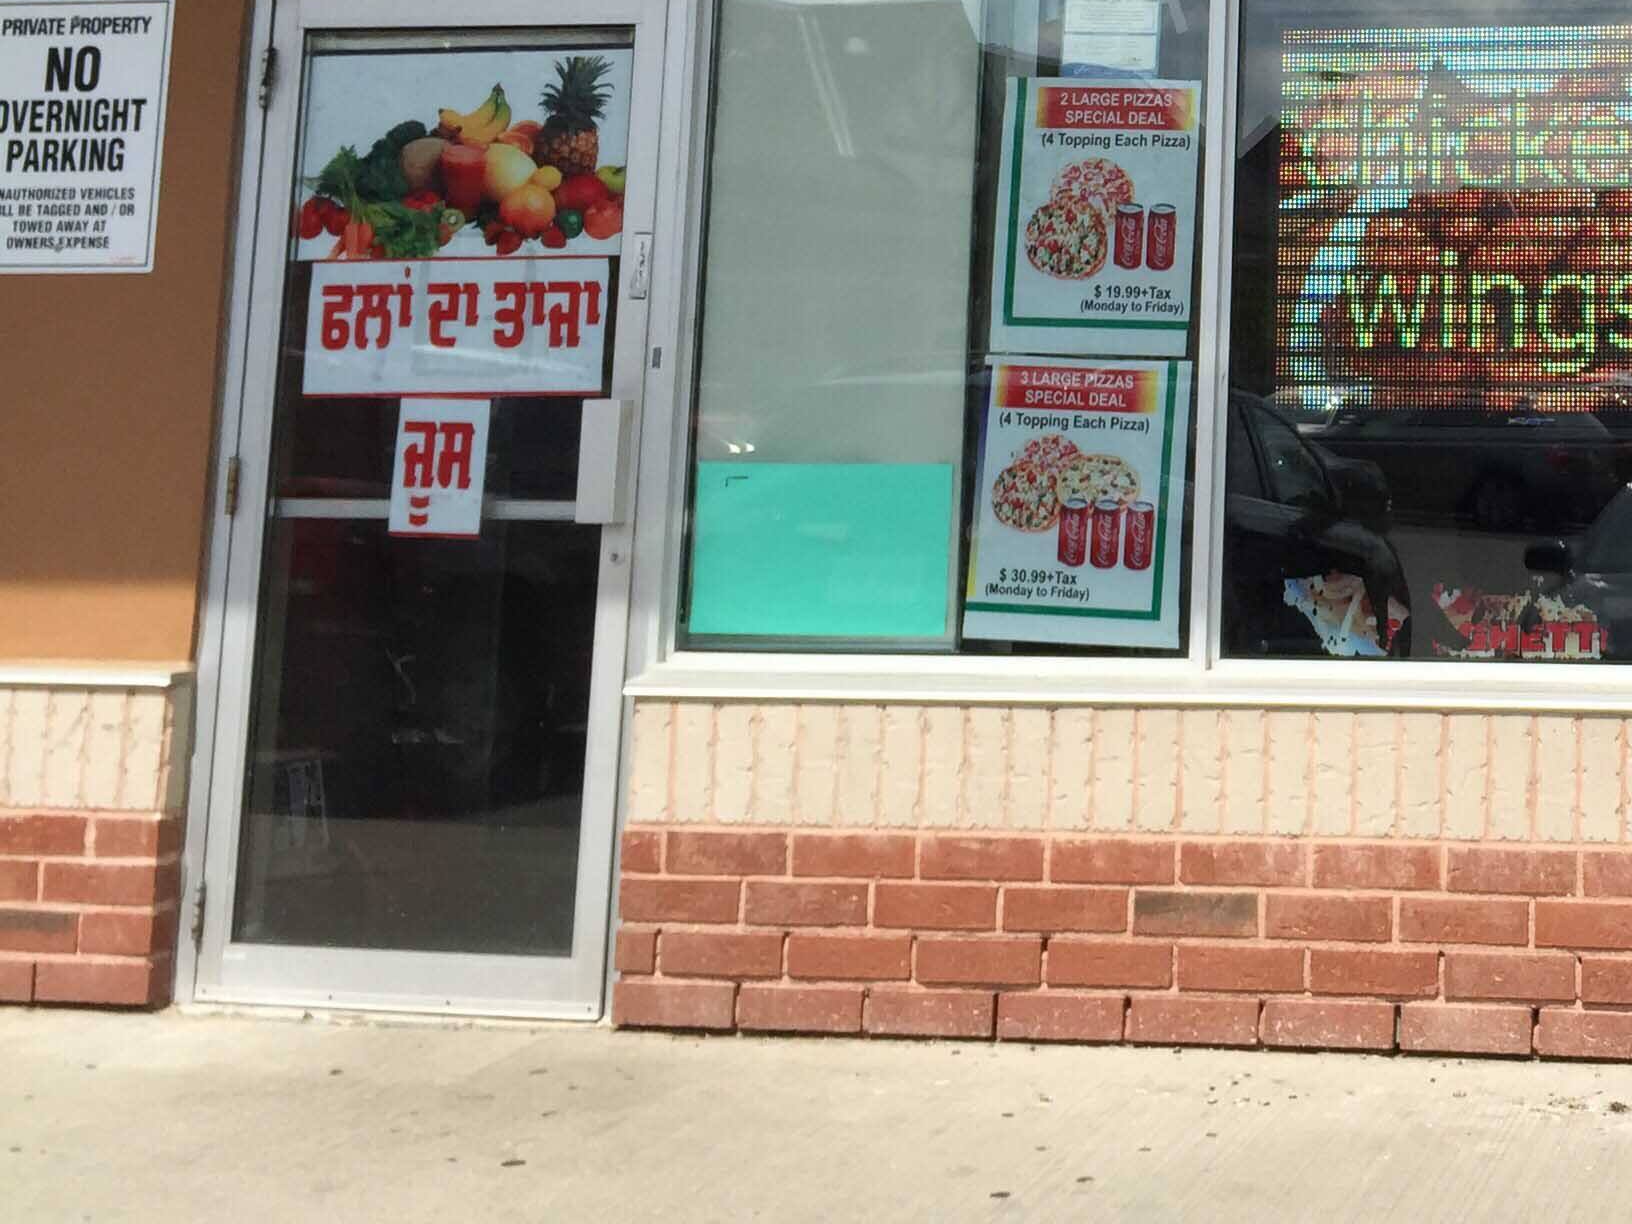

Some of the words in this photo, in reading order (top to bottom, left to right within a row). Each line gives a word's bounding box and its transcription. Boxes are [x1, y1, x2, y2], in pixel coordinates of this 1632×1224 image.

[2, 17, 66, 36] PRIVATE
[70, 16, 152, 35] PROPERTY
[45, 45, 102, 92] NO
[1059, 93, 1068, 106] 2
[1071, 92, 1119, 106] LARGE
[1123, 94, 1173, 107] PIZZAS
[0, 98, 147, 133] OVERNIGHT
[1065, 110, 1124, 125] SPECIAL
[1128, 111, 1165, 125] DEAL
[1041, 132, 1054, 148] (4
[1058, 133, 1110, 150] Topping
[1115, 134, 1148, 147] Each
[1151, 134, 1191, 150] Pizza)
[6, 138, 125, 173] PARKING
[80, 187, 136, 201] VEHICLES
[18, 204, 32, 217] BE
[37, 204, 81, 217] TAGGED
[85, 204, 108, 217] AND
[119, 204, 135, 216] OR
[13, 220, 52, 233] TOWED
[56, 220, 88, 233] AWAY
[93, 220, 106, 233] AT
[58, 236, 109, 249] EXPENSE
[1094, 285, 1102, 300] $
[427, 282, 479, 348] ਦਾ
[1080, 300, 1128, 314] (Monday
[1130, 301, 1142, 312] to
[1144, 301, 1184, 315] Friday)
[1020, 372, 1028, 385] 3
[1031, 372, 1080, 387] LARGE
[1083, 374, 1133, 389] PIZZAS
[1025, 389, 1084, 406] SPECIAL
[1088, 392, 1126, 407] DEAL
[999, 411, 1012, 427] (4
[1016, 412, 1069, 431] Topping
[1072, 415, 1106, 429] Each
[1110, 416, 1150, 433] Pizza)
[999, 568, 1006, 583] $
[984, 583, 1033, 598] (Monday
[1036, 586, 1048, 597] to
[1050, 587, 1090, 602] Friday)
